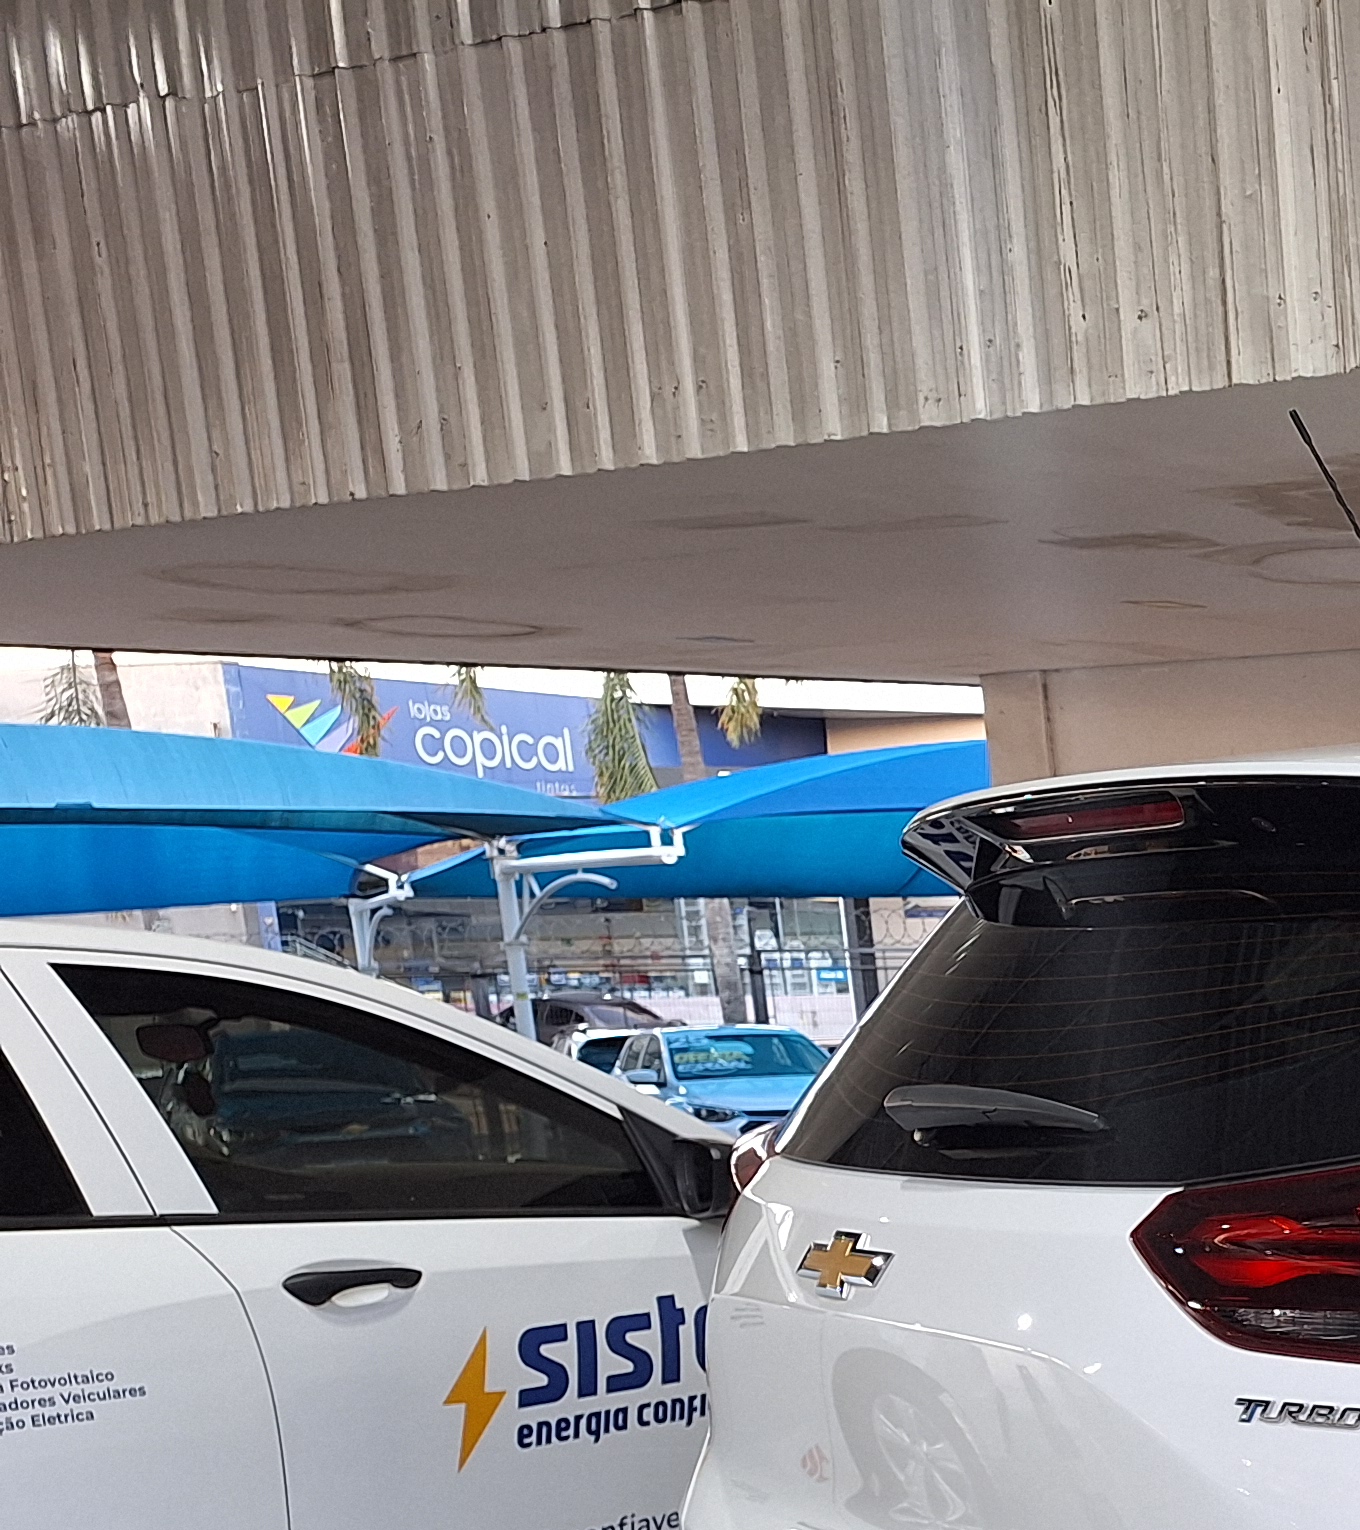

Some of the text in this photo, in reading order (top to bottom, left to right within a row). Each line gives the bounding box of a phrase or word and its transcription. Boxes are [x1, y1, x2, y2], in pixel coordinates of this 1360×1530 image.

[408, 699, 451, 722] lojas
[414, 724, 575, 779] copical
[9, 1369, 115, 1393] Fotovoltaico
[59, 1386, 147, 1406] Veiculares
[30, 1408, 95, 1428] Eletrica
[517, 1407, 629, 1448] energia
